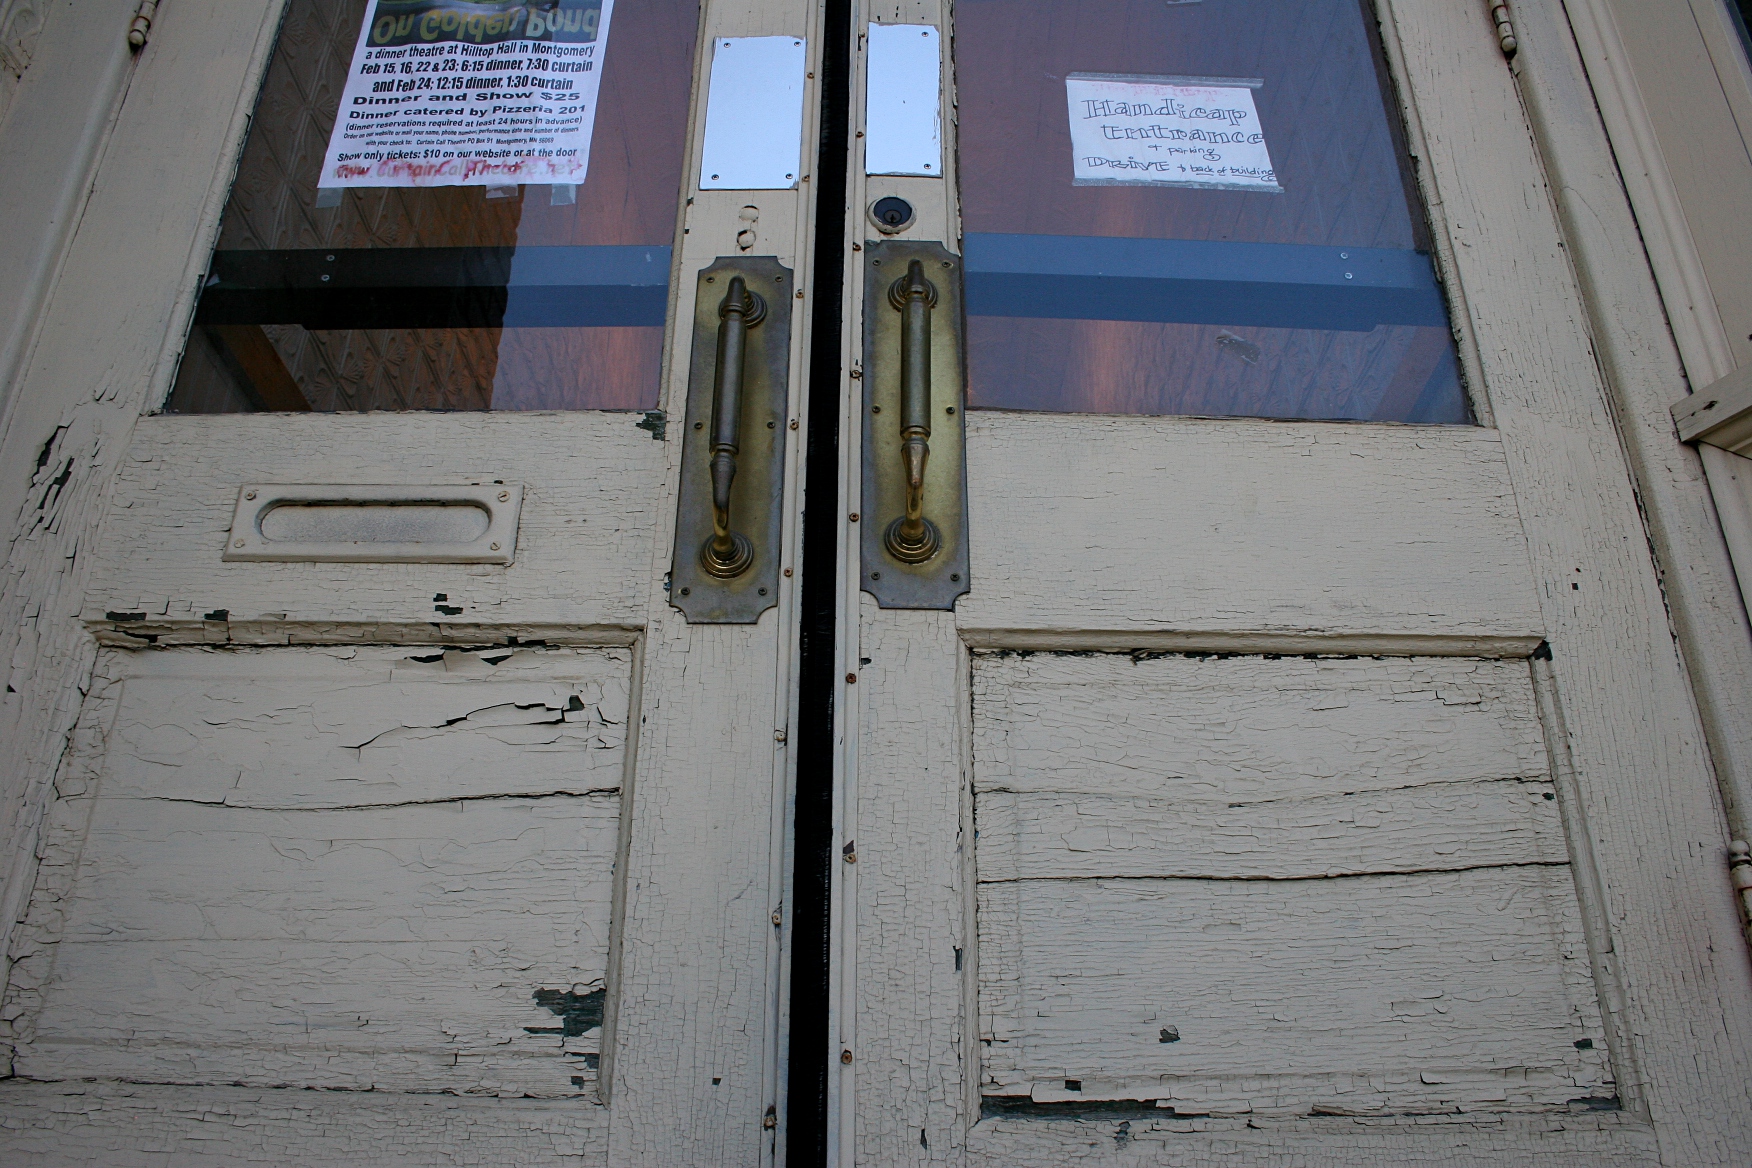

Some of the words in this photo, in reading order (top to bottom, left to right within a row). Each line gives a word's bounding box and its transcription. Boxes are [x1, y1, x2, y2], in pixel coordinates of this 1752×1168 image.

[366, 51, 372, 59] a
[375, 48, 407, 59] dinner
[409, 45, 445, 57] theatre
[447, 44, 458, 54] at
[461, 44, 494, 58] Hilltop
[496, 41, 517, 54] Hall
[519, 41, 528, 53] in
[531, 43, 595, 58] Montgomery
[360, 63, 381, 74] Feb
[383, 63, 396, 74] 15,
[400, 61, 414, 75] 16,
[415, 61, 431, 72] 22
[431, 62, 440, 72] &
[441, 59, 460, 72] 23;
[461, 60, 484, 72] 6:15
[485, 59, 524, 71] dinner,
[526, 58, 549, 71] 7:30
[551, 60, 593, 73] curtain
[372, 79, 395, 93] and
[396, 79, 416, 94] Feb
[417, 77, 434, 91] 24;
[436, 76, 464, 90] 12:15
[465, 76, 503, 89] dinner,
[506, 75, 529, 88] 1:30
[530, 76, 574, 90] curtain
[353, 95, 422, 105] Dinner
[428, 93, 468, 102] and
[475, 92, 533, 101] Show
[540, 92, 580, 101] $25
[349, 110, 399, 120] Dinner
[403, 107, 465, 116] catered
[469, 108, 488, 118] by
[492, 105, 553, 114] Pizzeria
[558, 105, 586, 115] 201
[1081, 98, 1247, 126] Handicap
[345, 123, 375, 132] (dinner
[376, 120, 426, 129] reservations
[428, 119, 463, 128] required
[476, 119, 496, 127] least
[510, 117, 533, 125] hours
[535, 116, 543, 125] in
[545, 116, 583, 125] advance)
[1101, 124, 1263, 144] Entrance
[338, 152, 362, 162] Show
[364, 149, 384, 162] only
[386, 150, 421, 160] tickets:
[423, 149, 441, 159] $10
[443, 150, 454, 159] on
[457, 150, 472, 159] our
[475, 148, 512, 159] website
[513, 148, 524, 157] or
[526, 148, 536, 157] at
[538, 147, 554, 158] the
[556, 147, 578, 158] door
[1167, 146, 1221, 161] parking
[1190, 164, 1214, 174] back
[1216, 166, 1228, 174] of
[1230, 166, 1277, 181] building
